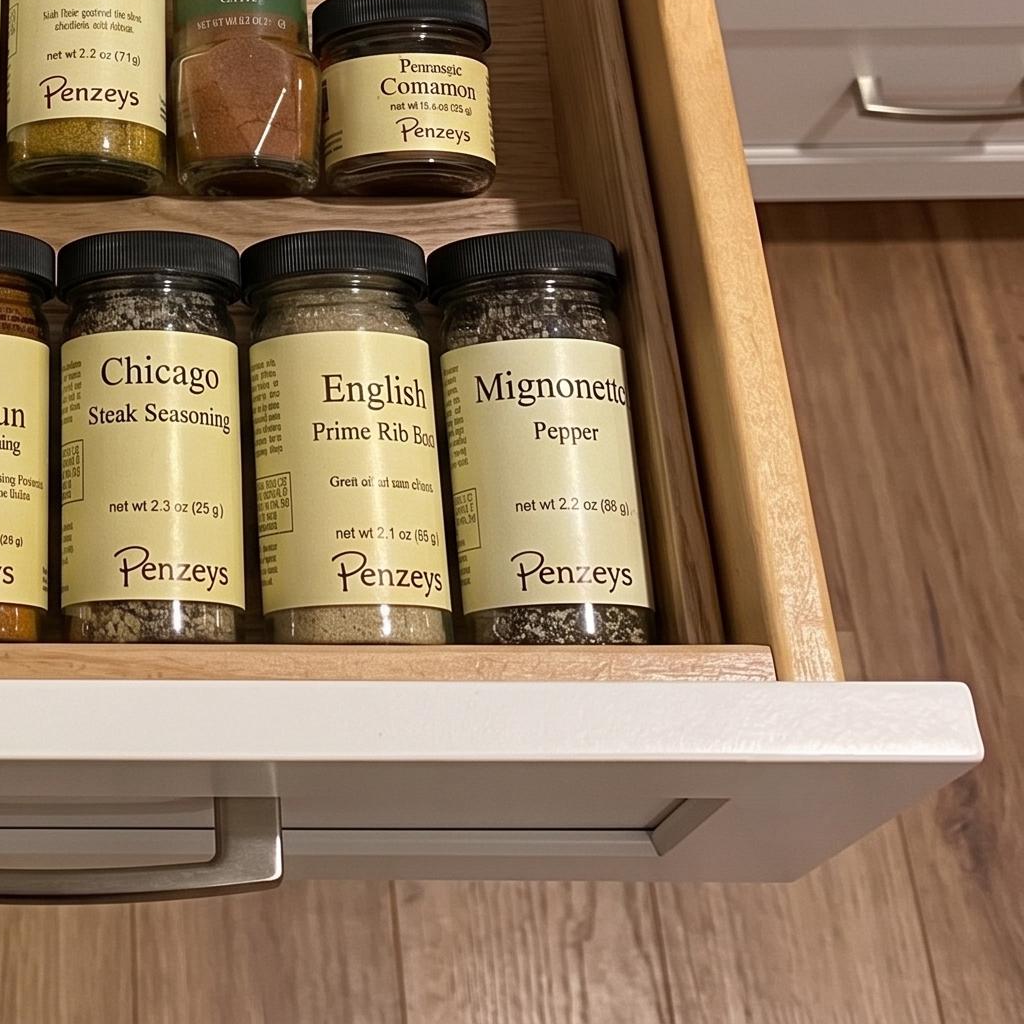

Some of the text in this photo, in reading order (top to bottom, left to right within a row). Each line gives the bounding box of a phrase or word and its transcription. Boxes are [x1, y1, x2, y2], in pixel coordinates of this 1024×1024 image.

[47, 51, 62, 61] net
[79, 48, 96, 58] 2.2
[39, 76, 139, 109] Penzeys
[396, 117, 471, 145] Penzeys
[101, 355, 219, 394] Chicago
[321, 374, 427, 411] English
[88, 403, 231, 435] Steak Seasoning
[312, 421, 371, 441] Prime
[377, 422, 409, 442] Rib
[533, 422, 599, 445] Pepper
[109, 500, 224, 519] net wt 2.3 oz (25 g)
[515, 500, 536, 512] net
[539, 498, 556, 510] wt
[559, 497, 579, 510] 2.2
[584, 500, 598, 510] oz
[601, 499, 617, 514] (88
[15, 537, 24, 547] g)
[336, 527, 355, 539] net
[359, 528, 374, 539] wt
[377, 527, 395, 540] 2.1
[398, 530, 412, 541] oz
[114, 546, 229, 592] Penzeys
[331, 551, 442, 598] Penzeys
[510, 551, 633, 593] Penzeys
